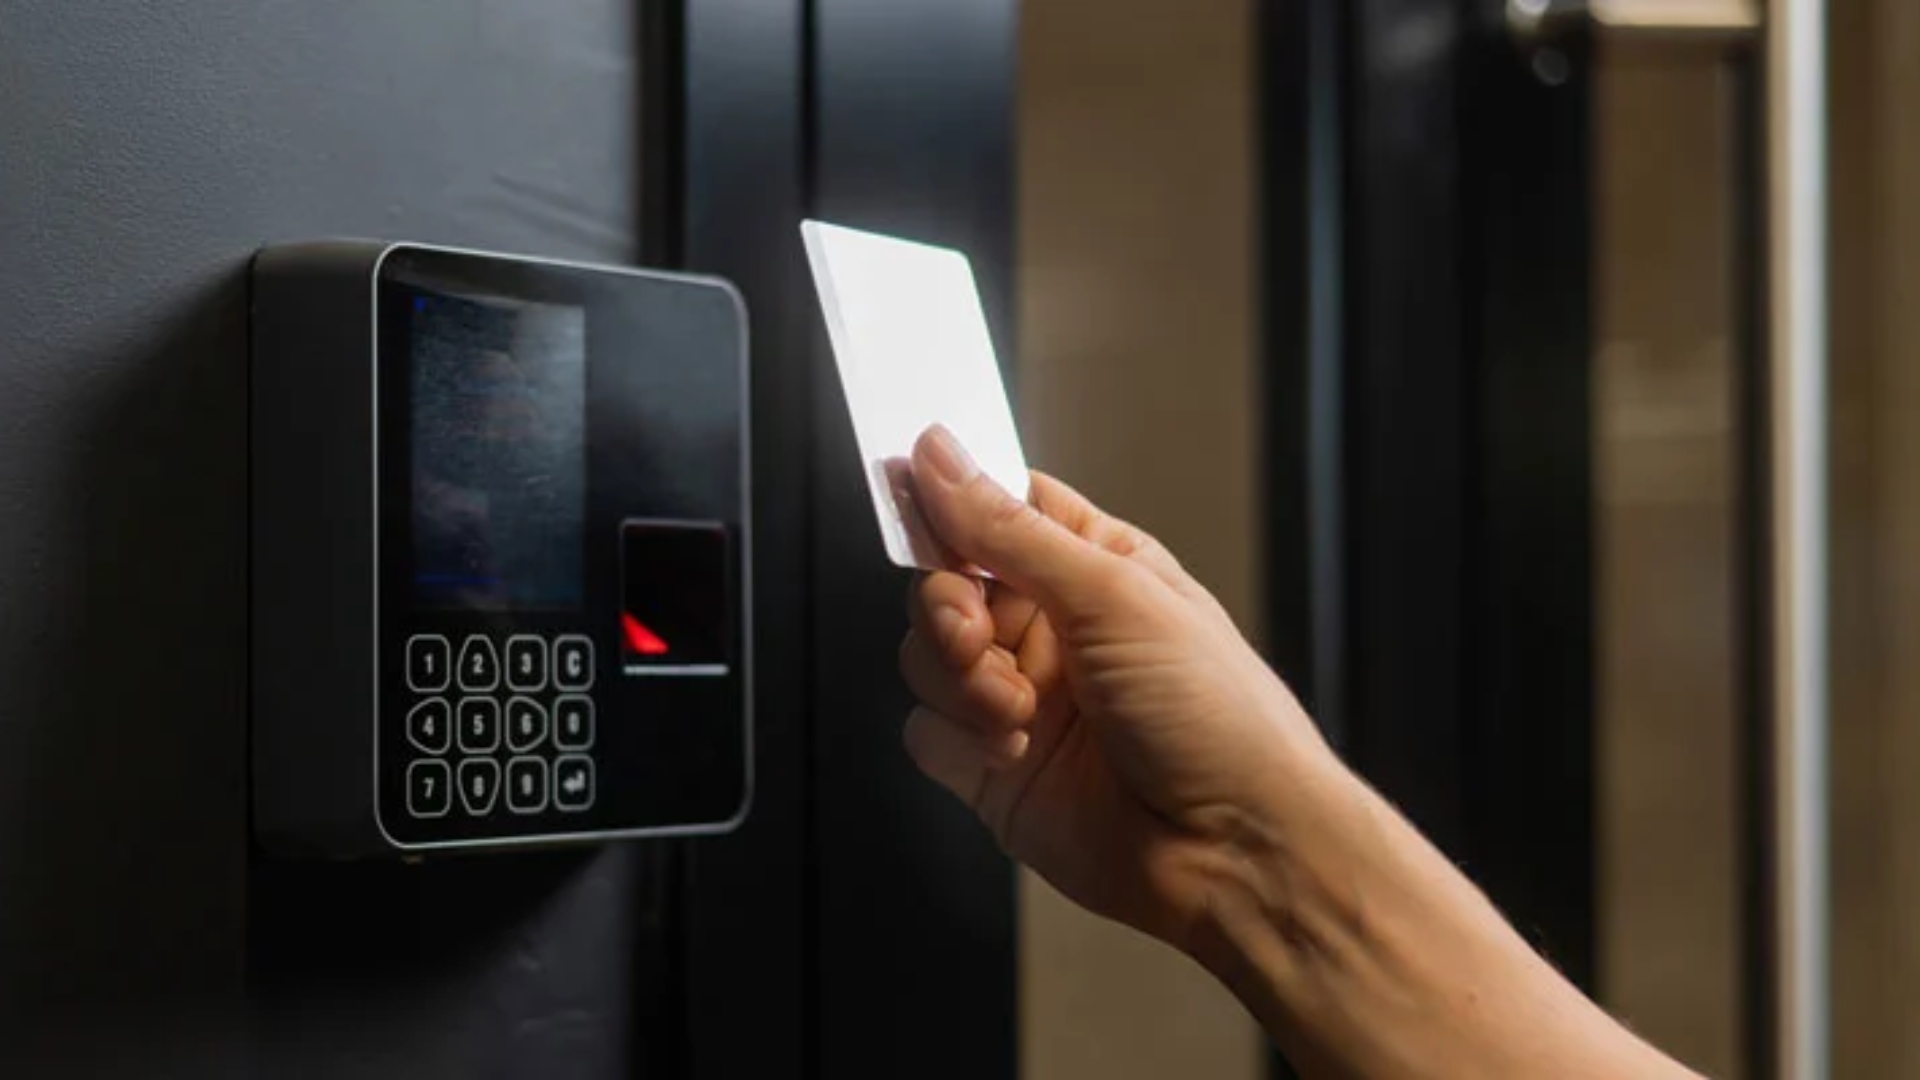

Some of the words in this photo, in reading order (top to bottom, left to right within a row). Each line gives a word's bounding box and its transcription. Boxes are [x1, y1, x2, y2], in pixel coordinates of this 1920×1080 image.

[424, 653, 433, 674] 1
[472, 653, 484, 674] 2
[521, 652, 532, 674] 3
[566, 650, 581, 677] C
[422, 715, 434, 736] 4
[473, 714, 484, 736] 5
[521, 712, 532, 735] 6
[423, 777, 435, 798] 7
